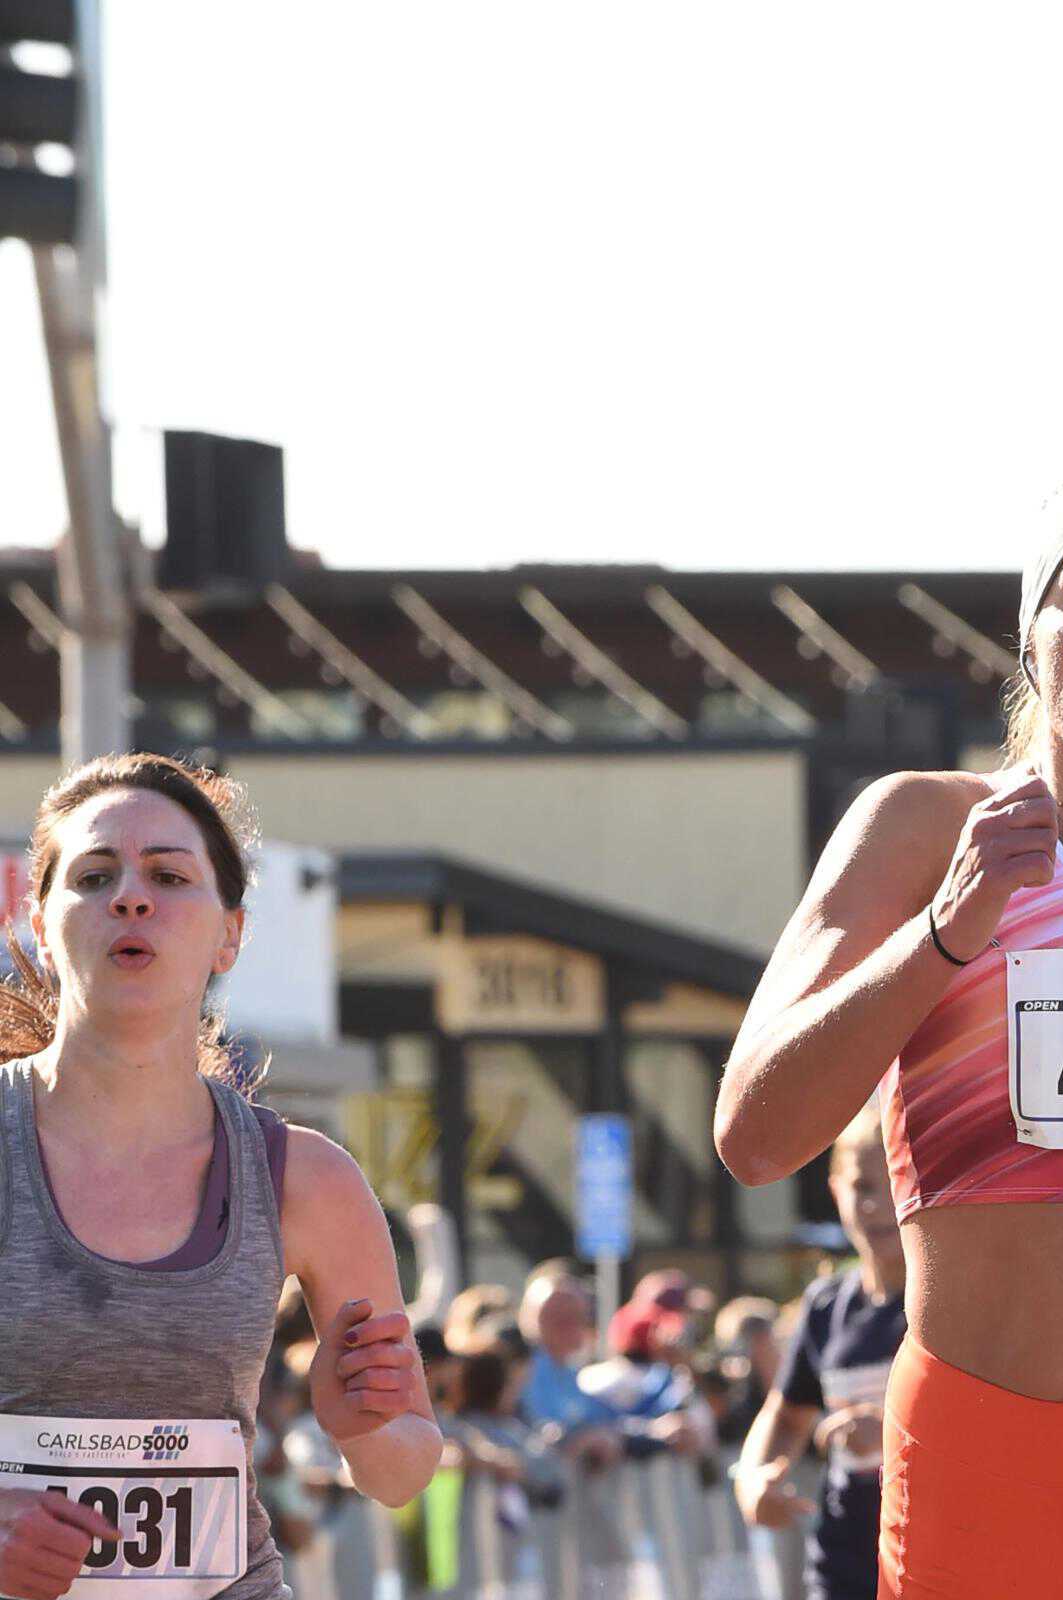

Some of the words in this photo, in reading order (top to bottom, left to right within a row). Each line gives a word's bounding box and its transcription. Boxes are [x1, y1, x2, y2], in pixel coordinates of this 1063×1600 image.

[1024, 1001, 1060, 1012] OPEN
[37, 1432, 190, 1451] CARLSBAD5000
[0, 1462, 25, 1473] PEN
[46, 1485, 193, 1569] 031
